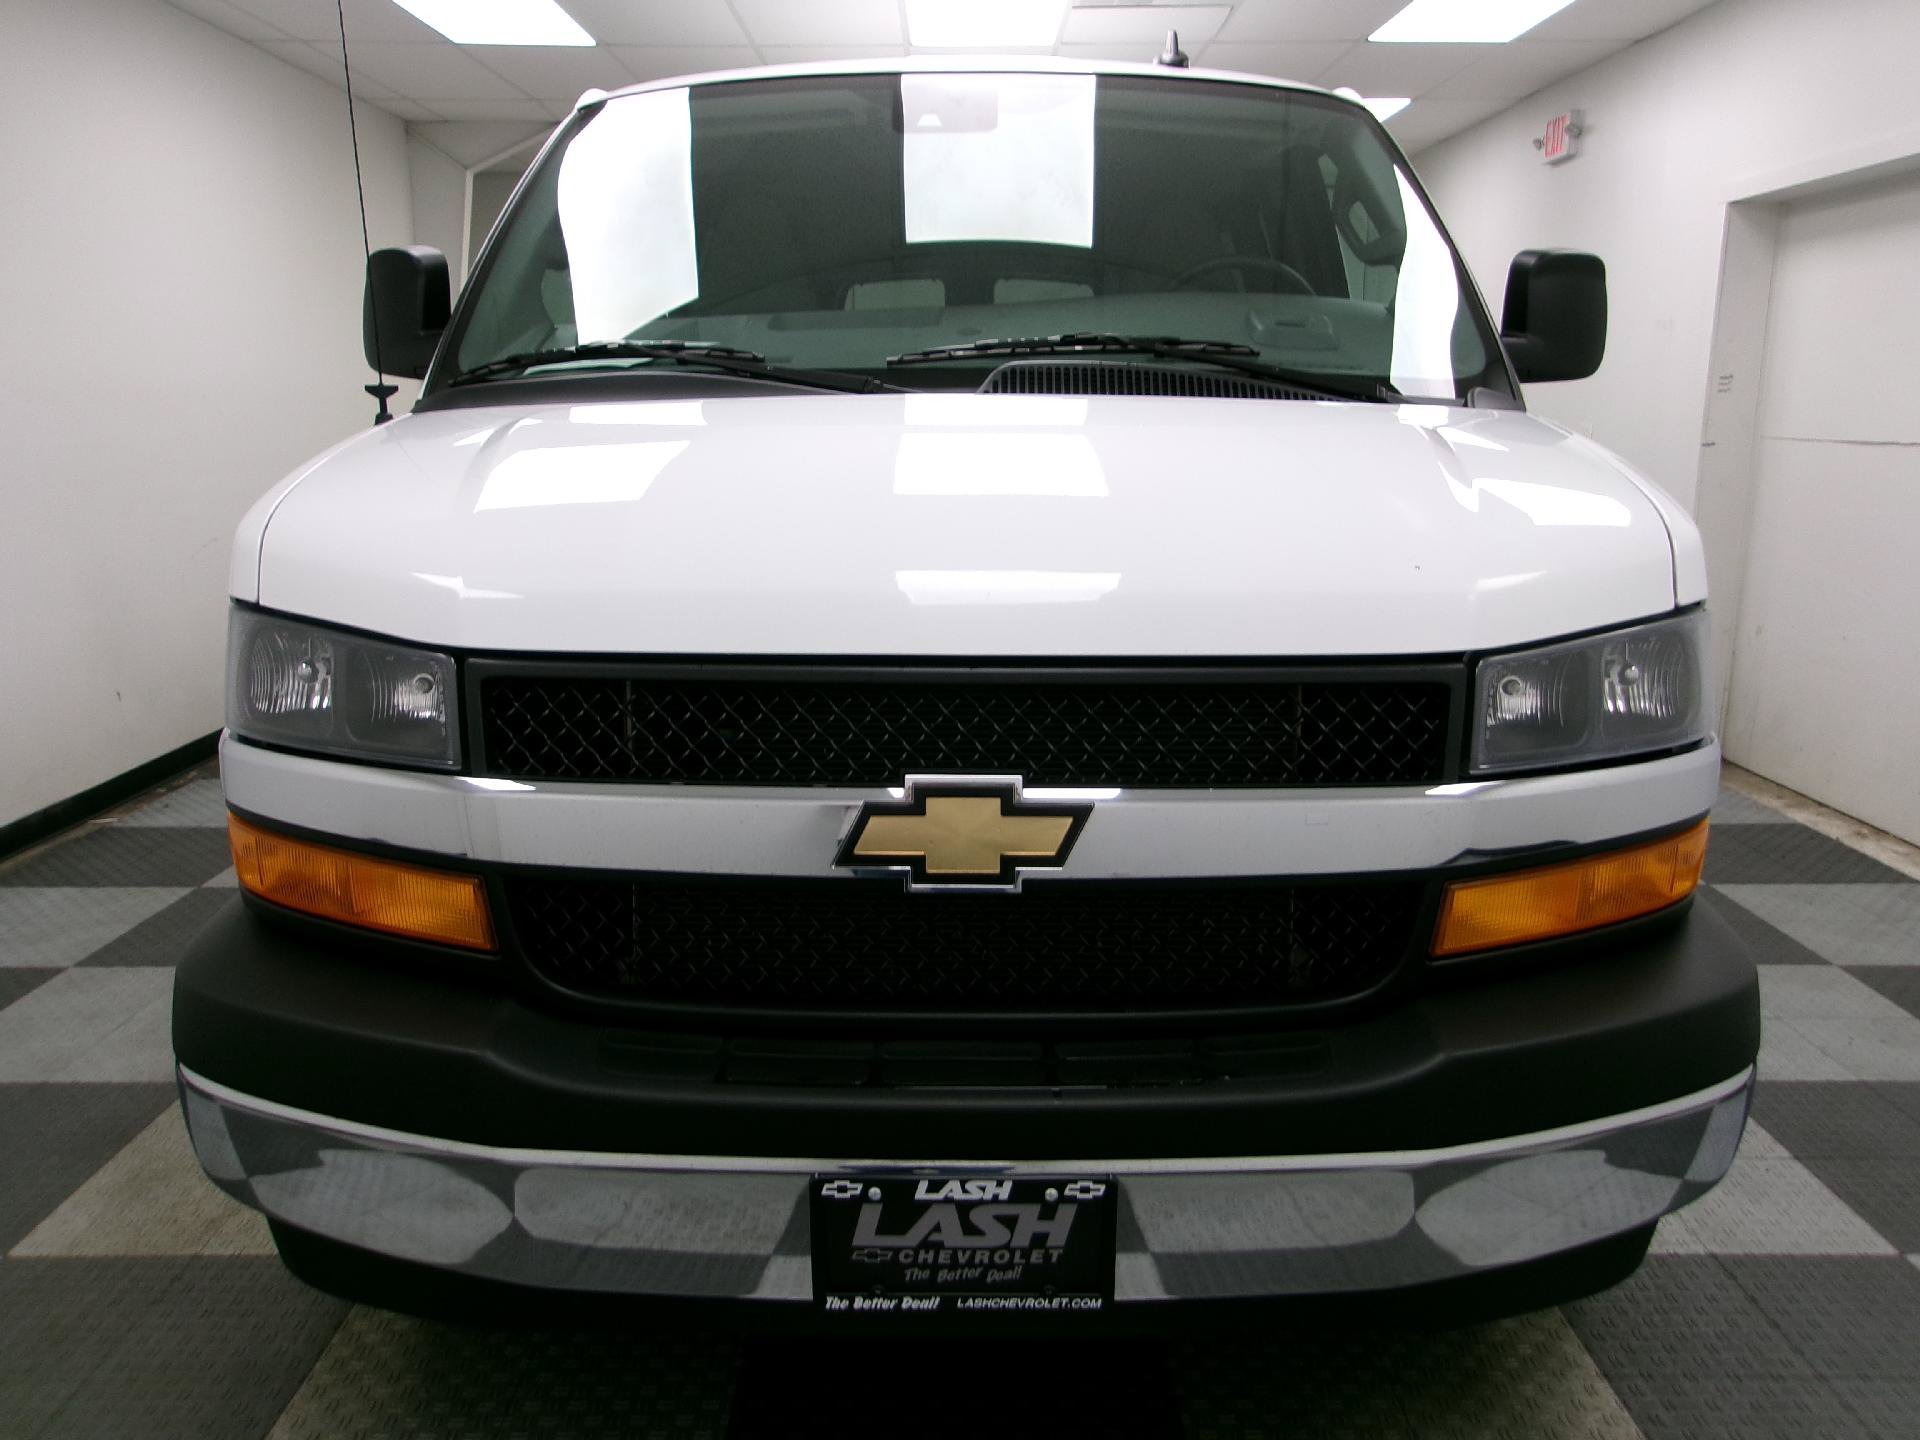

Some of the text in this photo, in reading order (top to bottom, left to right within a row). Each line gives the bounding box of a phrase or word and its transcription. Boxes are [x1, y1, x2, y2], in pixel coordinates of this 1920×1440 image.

[914, 1180, 1014, 1200] LASH
[852, 1202, 1079, 1248] LASH
[899, 1249, 1064, 1264] CHEVROLET
[904, 1267, 931, 1281] The
[937, 1266, 984, 1283] Better
[825, 1296, 849, 1310] The
[853, 1296, 898, 1310] Better
[957, 1297, 1102, 1309] LASHCHEVROLET.COM
